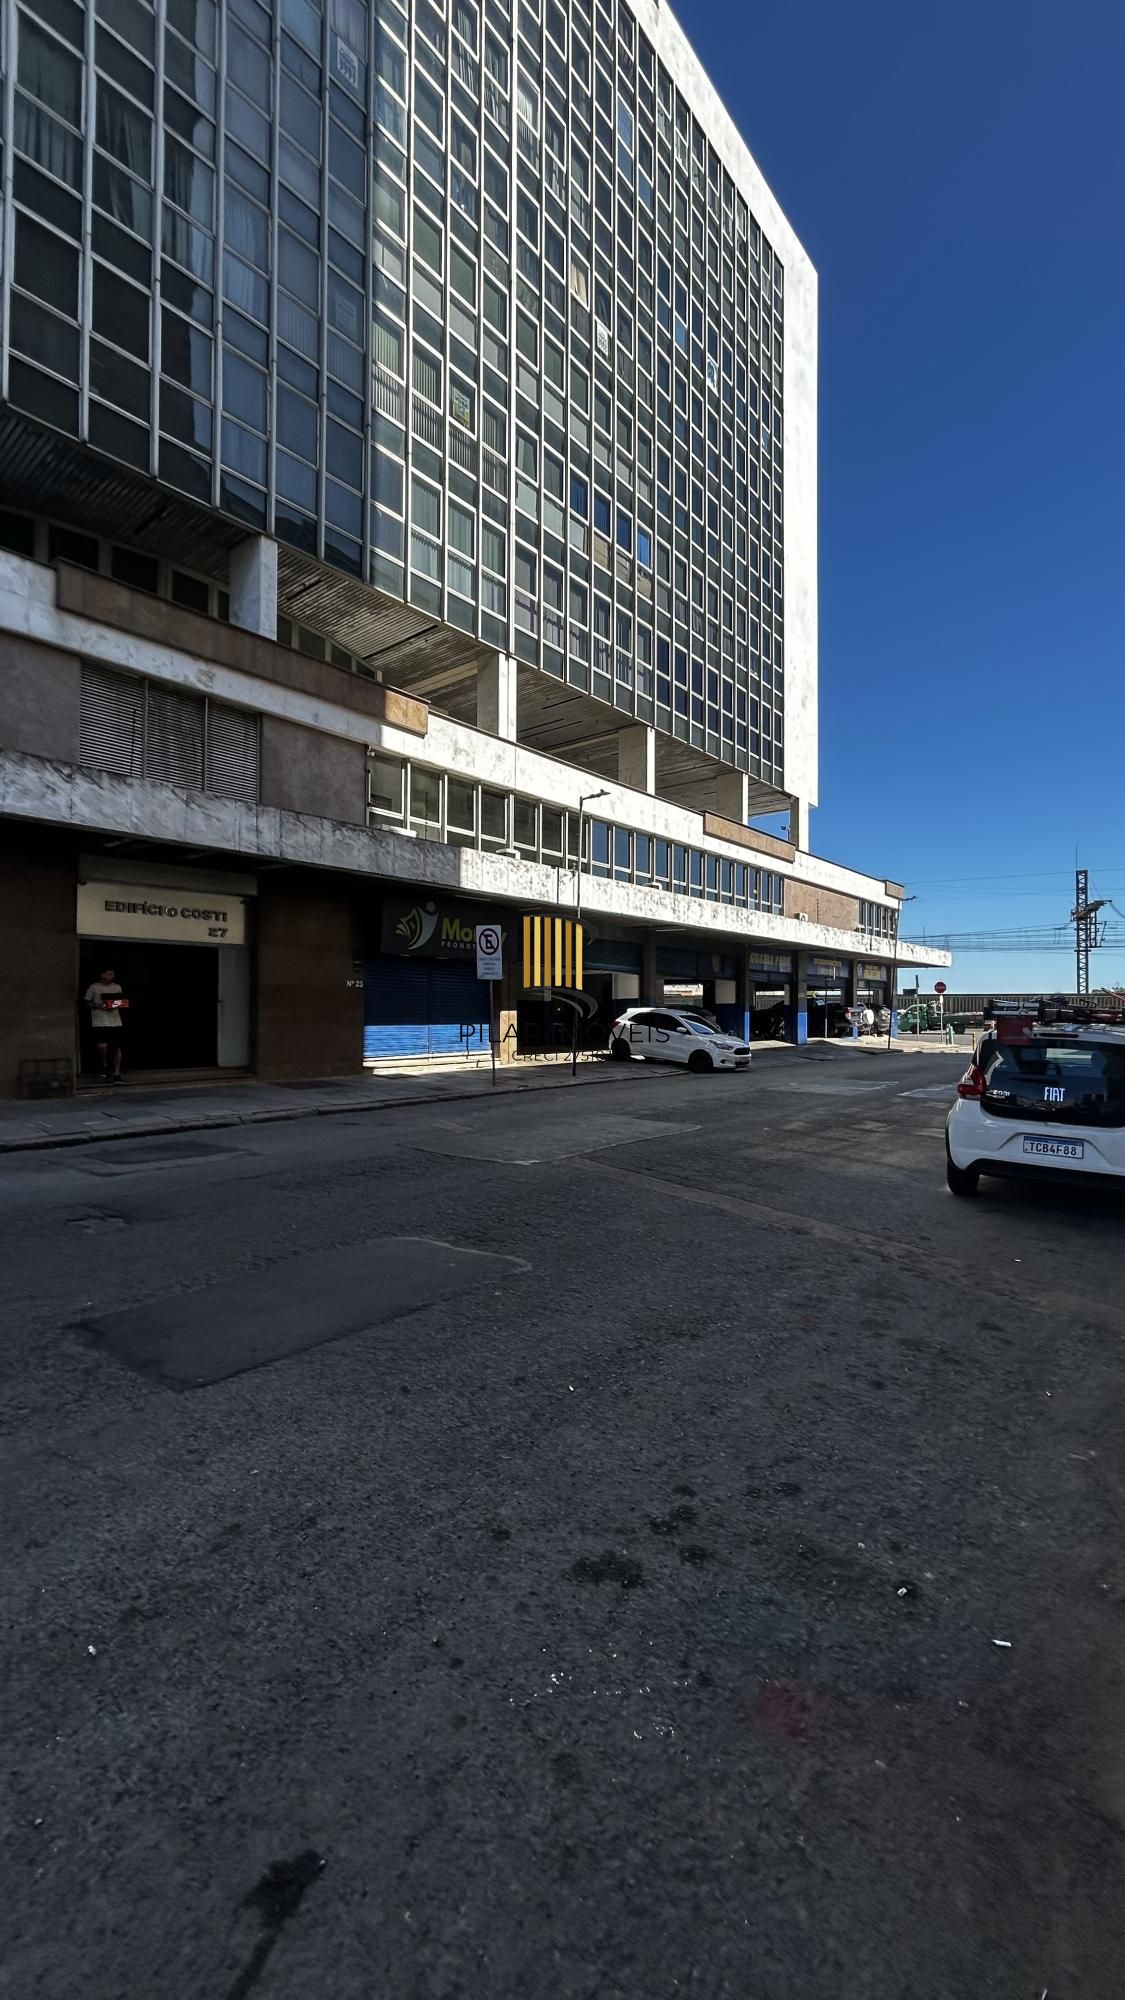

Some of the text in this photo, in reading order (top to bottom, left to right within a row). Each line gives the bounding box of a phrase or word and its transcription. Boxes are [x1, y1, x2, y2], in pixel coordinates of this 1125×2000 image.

[104, 900, 228, 922] EDIFÍCIO COSTI
[1044, 1086, 1066, 1102] FIAT
[1029, 1142, 1077, 1156] TCB4F88
